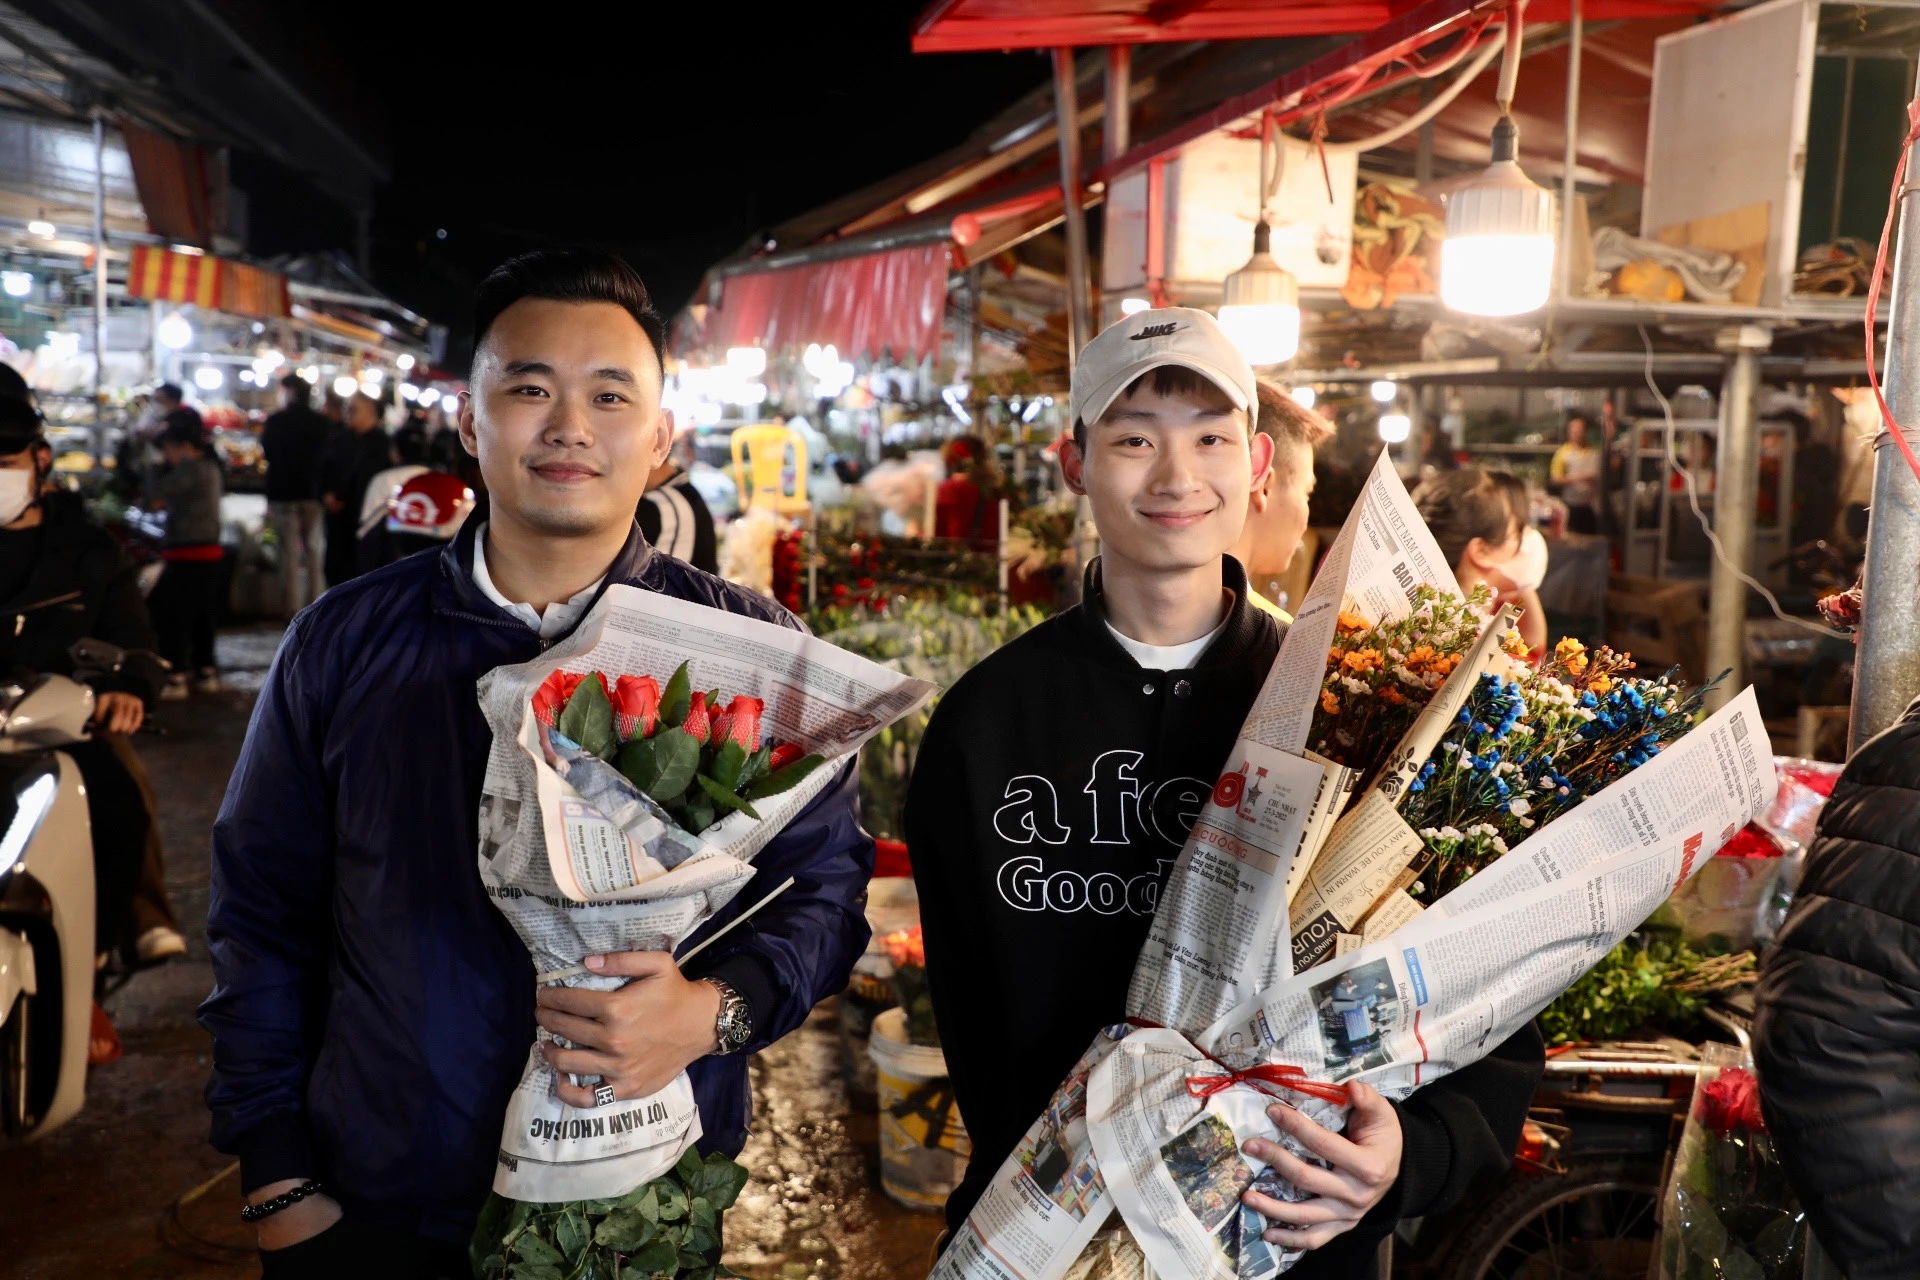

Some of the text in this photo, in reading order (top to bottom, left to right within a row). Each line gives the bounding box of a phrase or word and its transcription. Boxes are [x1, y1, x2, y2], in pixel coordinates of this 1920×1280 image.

[1141, 322, 1177, 336] NIKE
[1400, 529, 1419, 553] NAM
[1730, 710, 1743, 725] 6
[993, 774, 1071, 845] a
[1325, 828, 1408, 897] MAY YOU BE WARM IN
[495, 884, 523, 902] dịch
[1305, 900, 1323, 917] SHE
[1291, 915, 1339, 957] YOUR
[1298, 950, 1316, 969] YOU
[608, 1107, 645, 1136] NĂM
